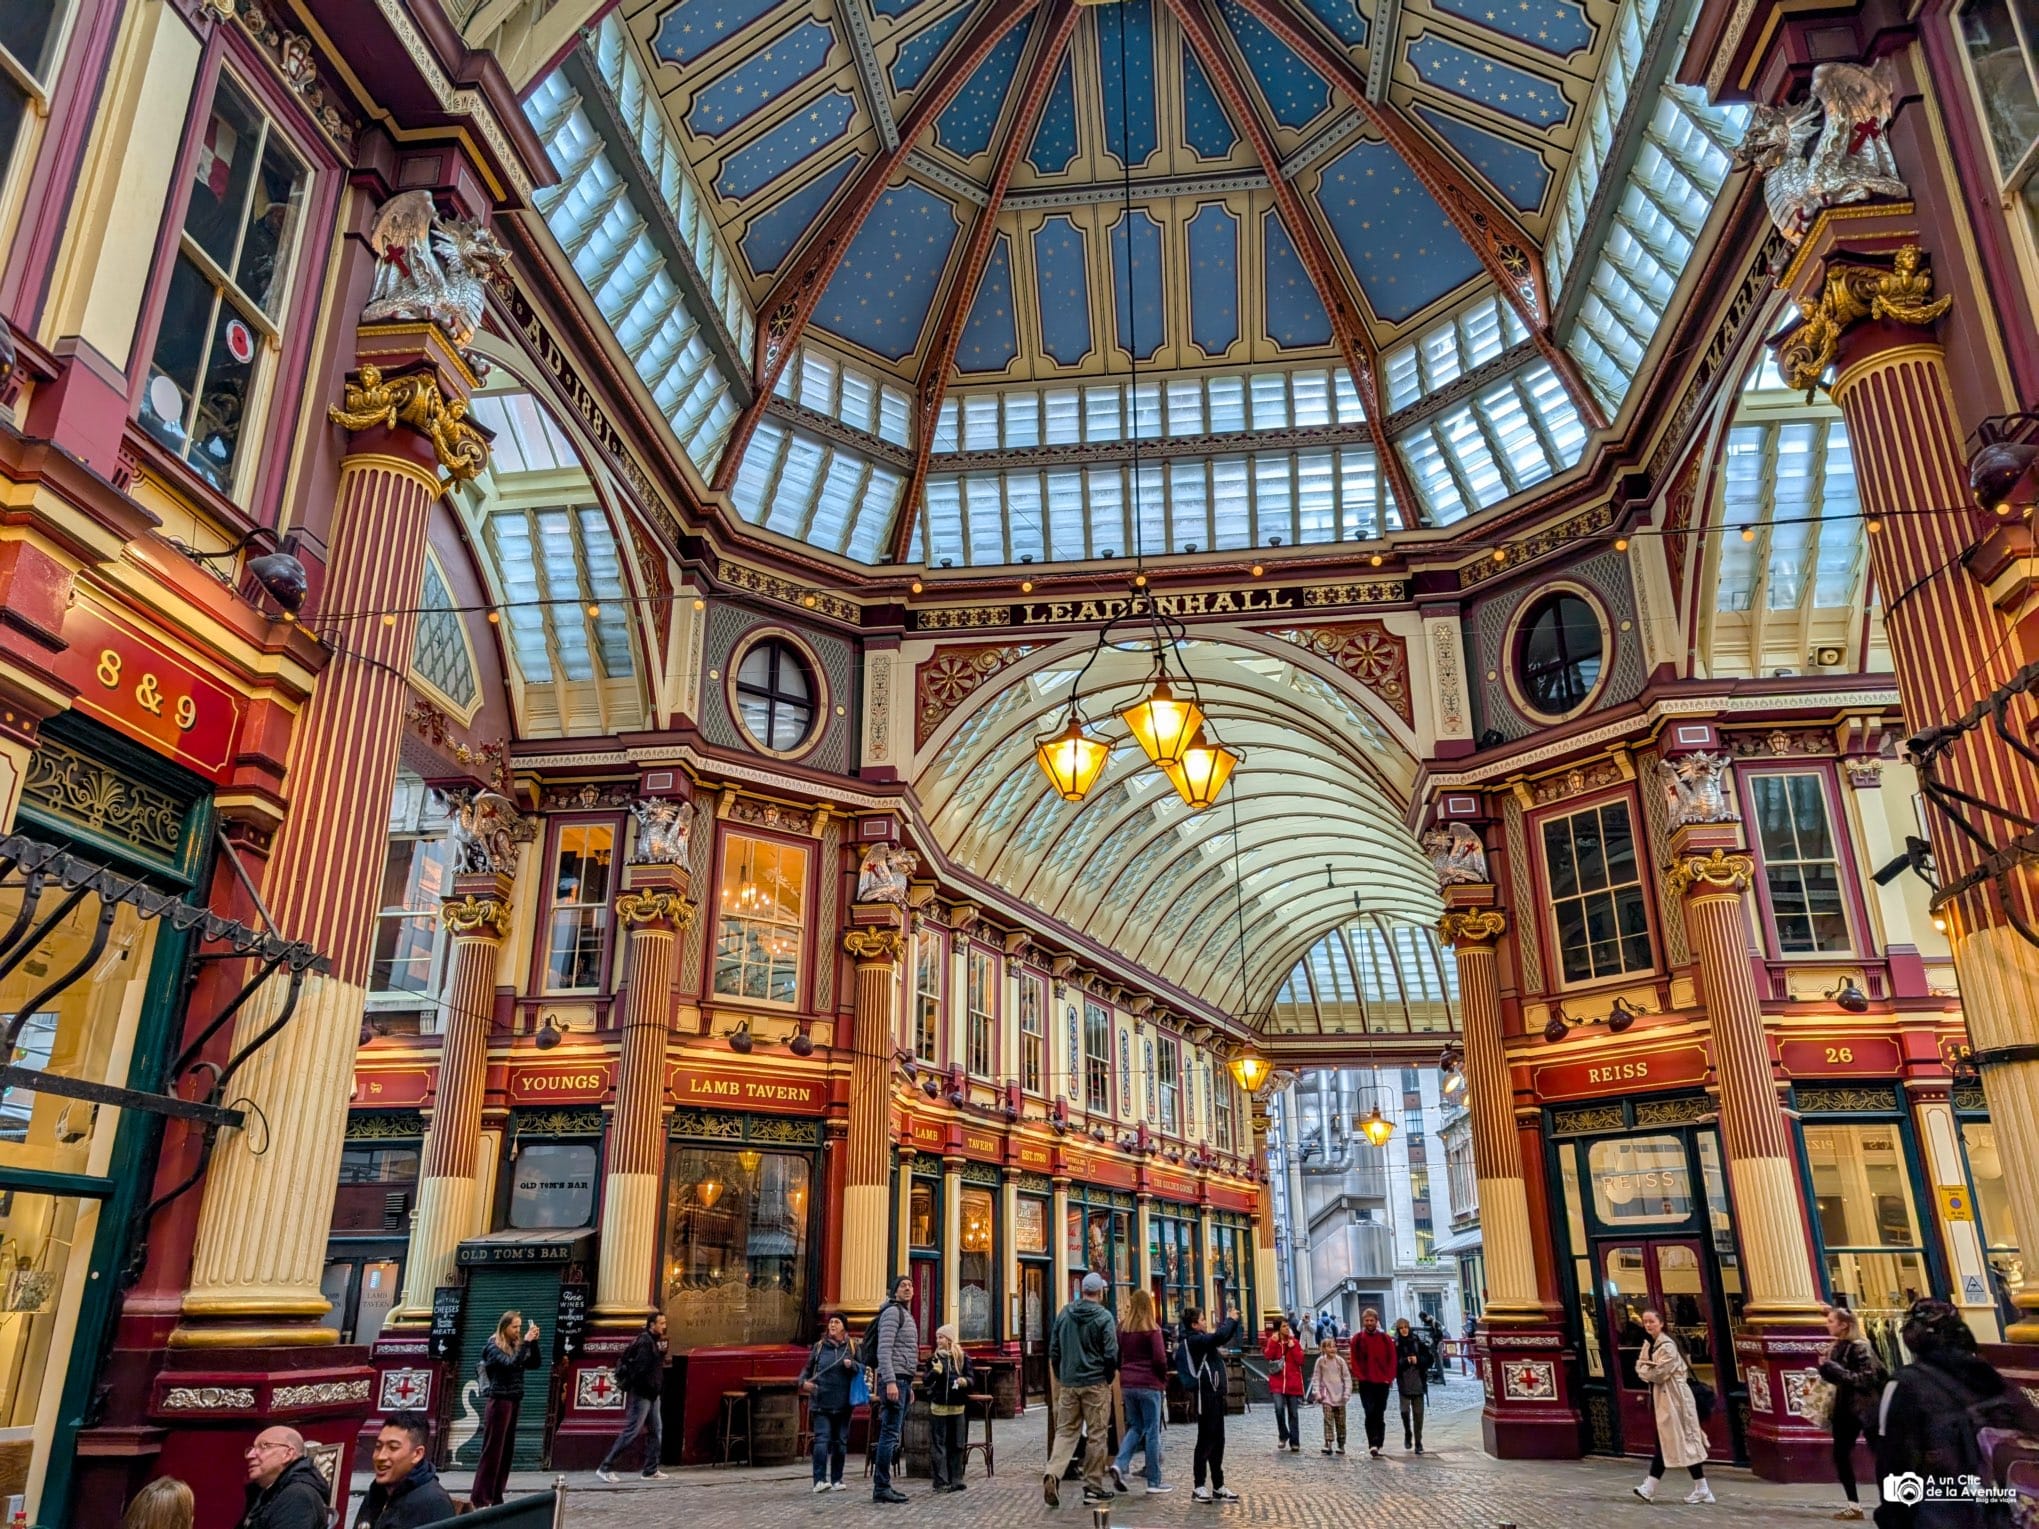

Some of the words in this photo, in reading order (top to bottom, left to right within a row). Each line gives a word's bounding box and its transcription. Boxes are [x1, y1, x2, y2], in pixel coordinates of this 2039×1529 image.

[1705, 226, 1783, 374] MARKE
[570, 379, 614, 450] 1881
[1022, 589, 1293, 624] LEADENHALL
[96, 648, 122, 688] 8
[135, 672, 164, 715] &
[174, 694, 197, 730] 9
[1825, 1047, 1854, 1064] 26
[1588, 1062, 1648, 1084] REISS
[521, 1074, 600, 1091] YOUNGS
[690, 1078, 740, 1096] LAMB
[746, 1083, 811, 1101] TAVERN
[915, 1127, 939, 1142] LAMB
[967, 1137, 994, 1153] TAVERN
[520, 1182, 537, 1190] OLD
[539, 1182, 565, 1190] TOM'S
[567, 1182, 589, 1190] BAR
[1602, 1171, 1675, 1191] REISS
[461, 1250, 488, 1261] OLD
[493, 1249, 535, 1260] TOM'S
[540, 1247, 569, 1259] BAR
[433, 1305, 460, 1314] CHEESES
